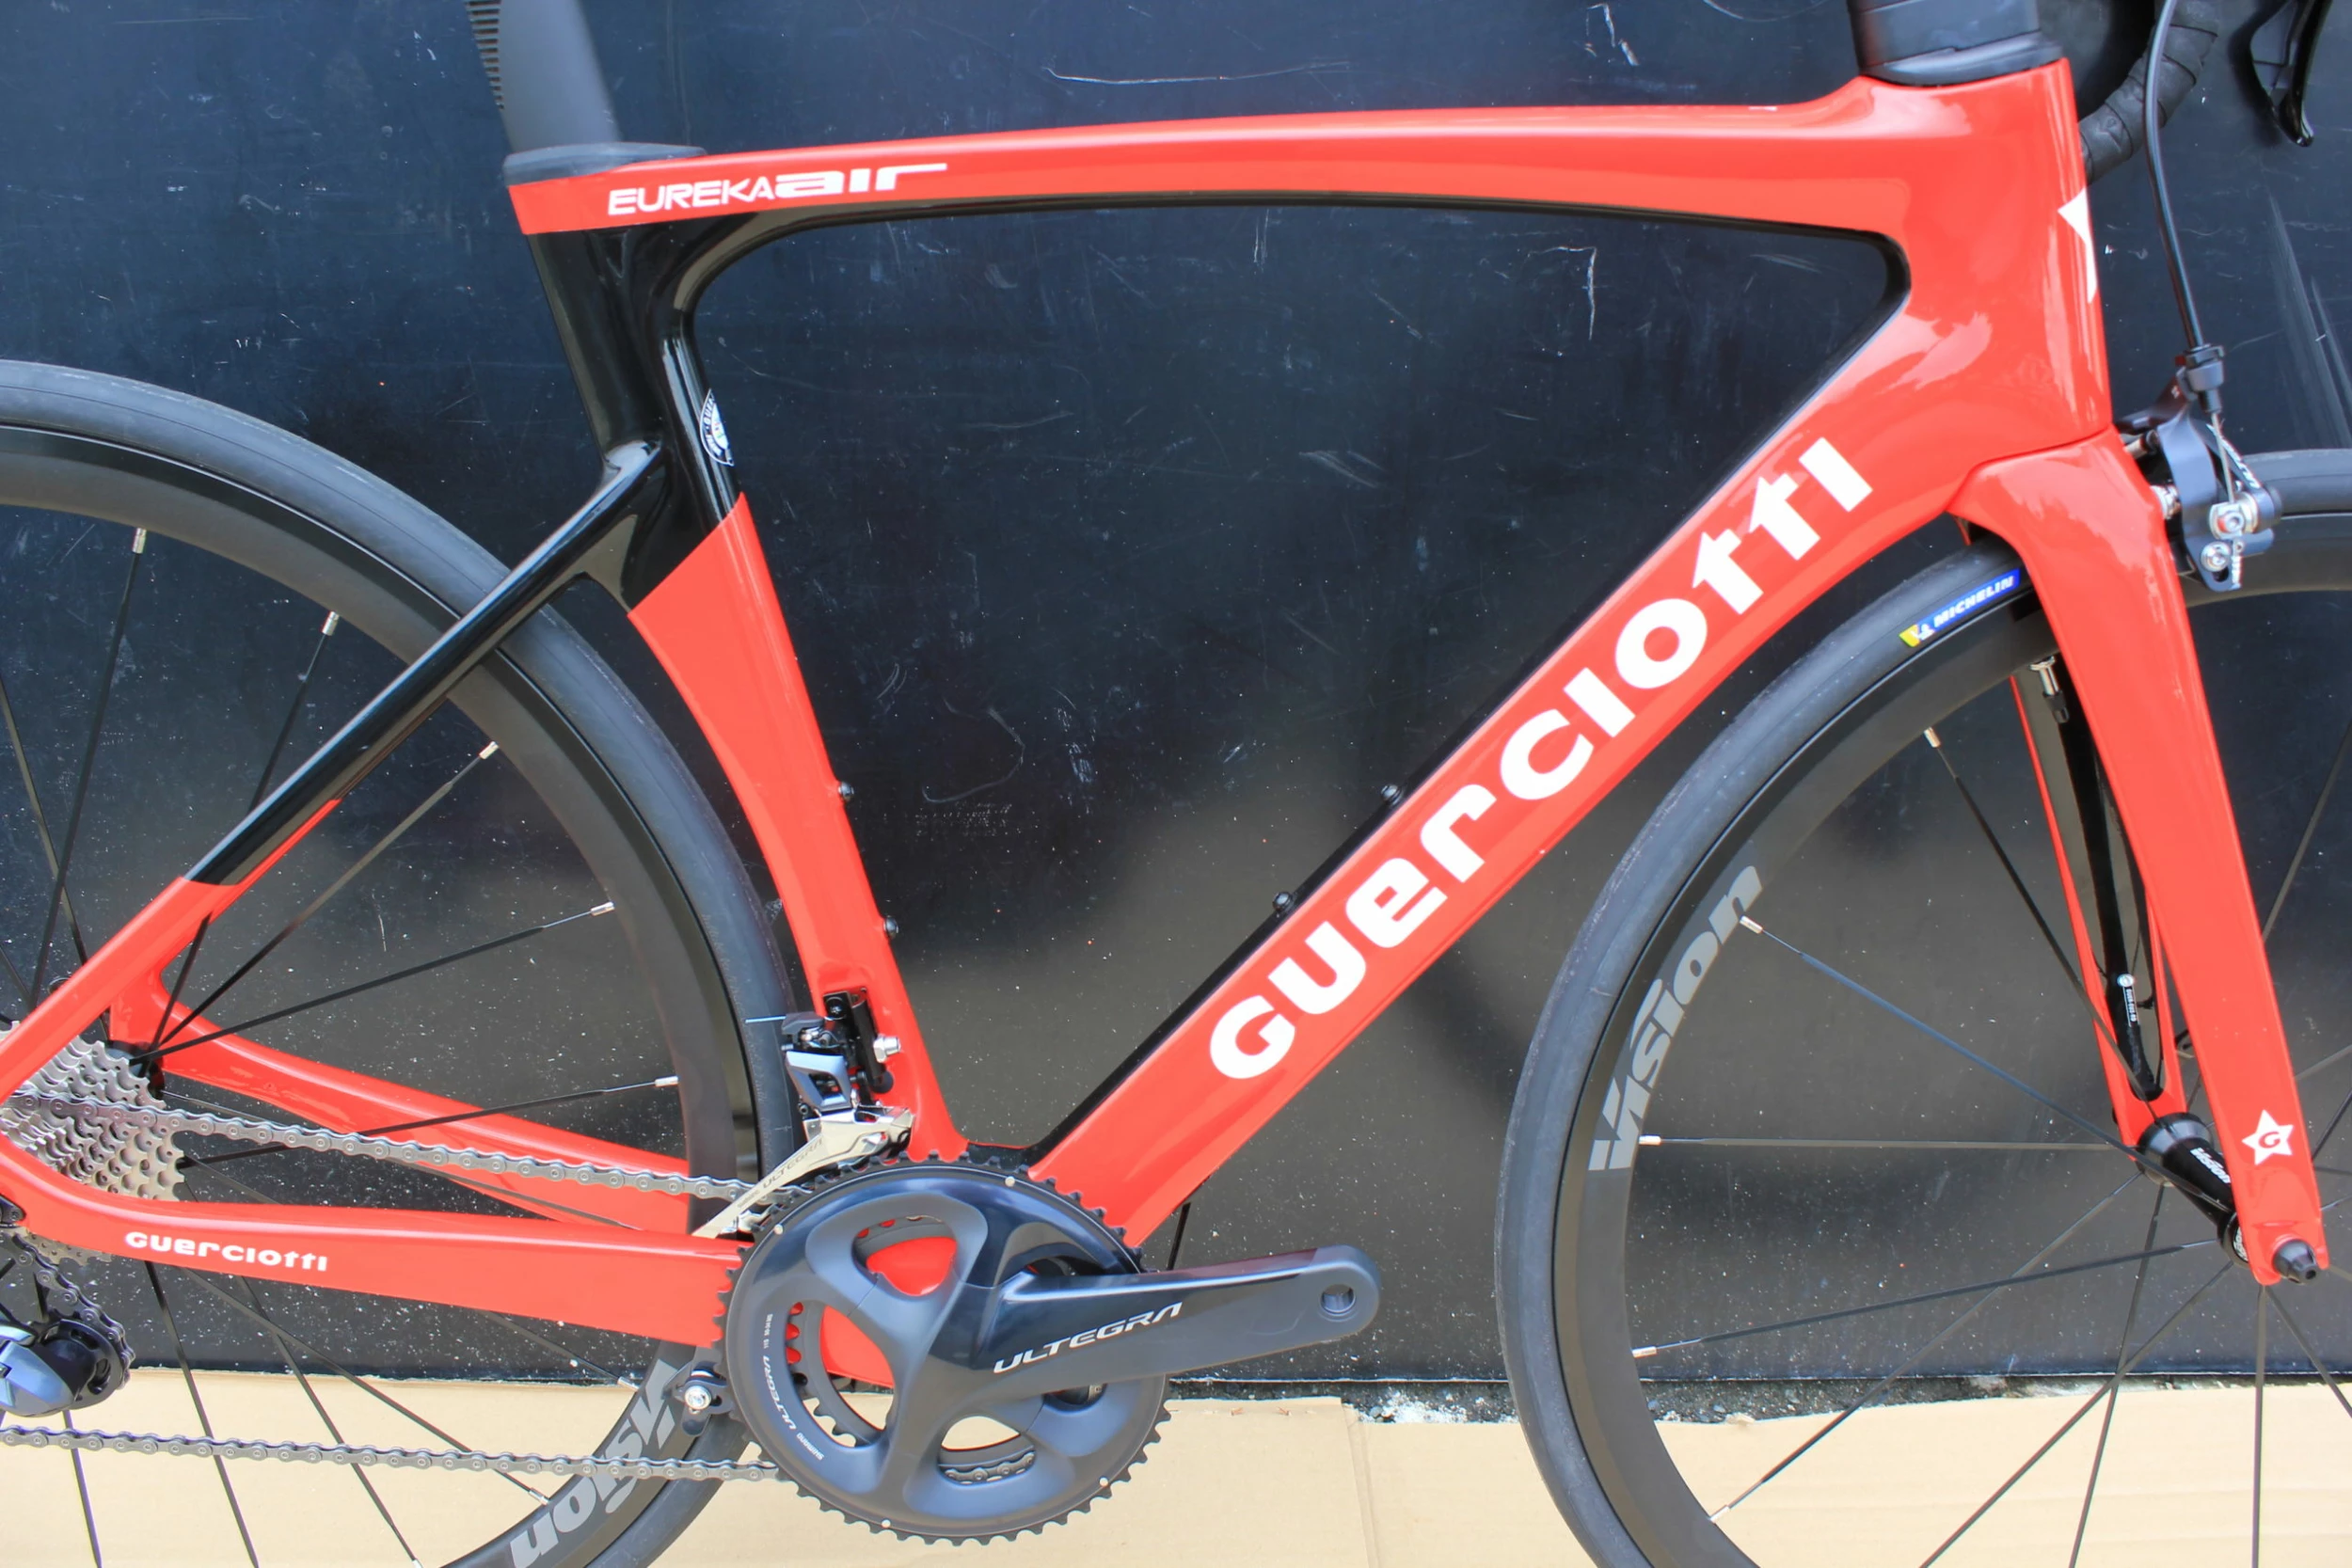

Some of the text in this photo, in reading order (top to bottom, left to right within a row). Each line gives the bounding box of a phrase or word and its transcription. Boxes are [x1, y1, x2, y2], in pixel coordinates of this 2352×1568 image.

[1933, 575, 2014, 628] MICHELIN
[762, 1138, 823, 1190] ULTEGRA
[993, 1301, 1184, 1374] ULTEGRA
[763, 1354, 797, 1431] ULTEGRA
[796, 1432, 825, 1461] SHIMANO
